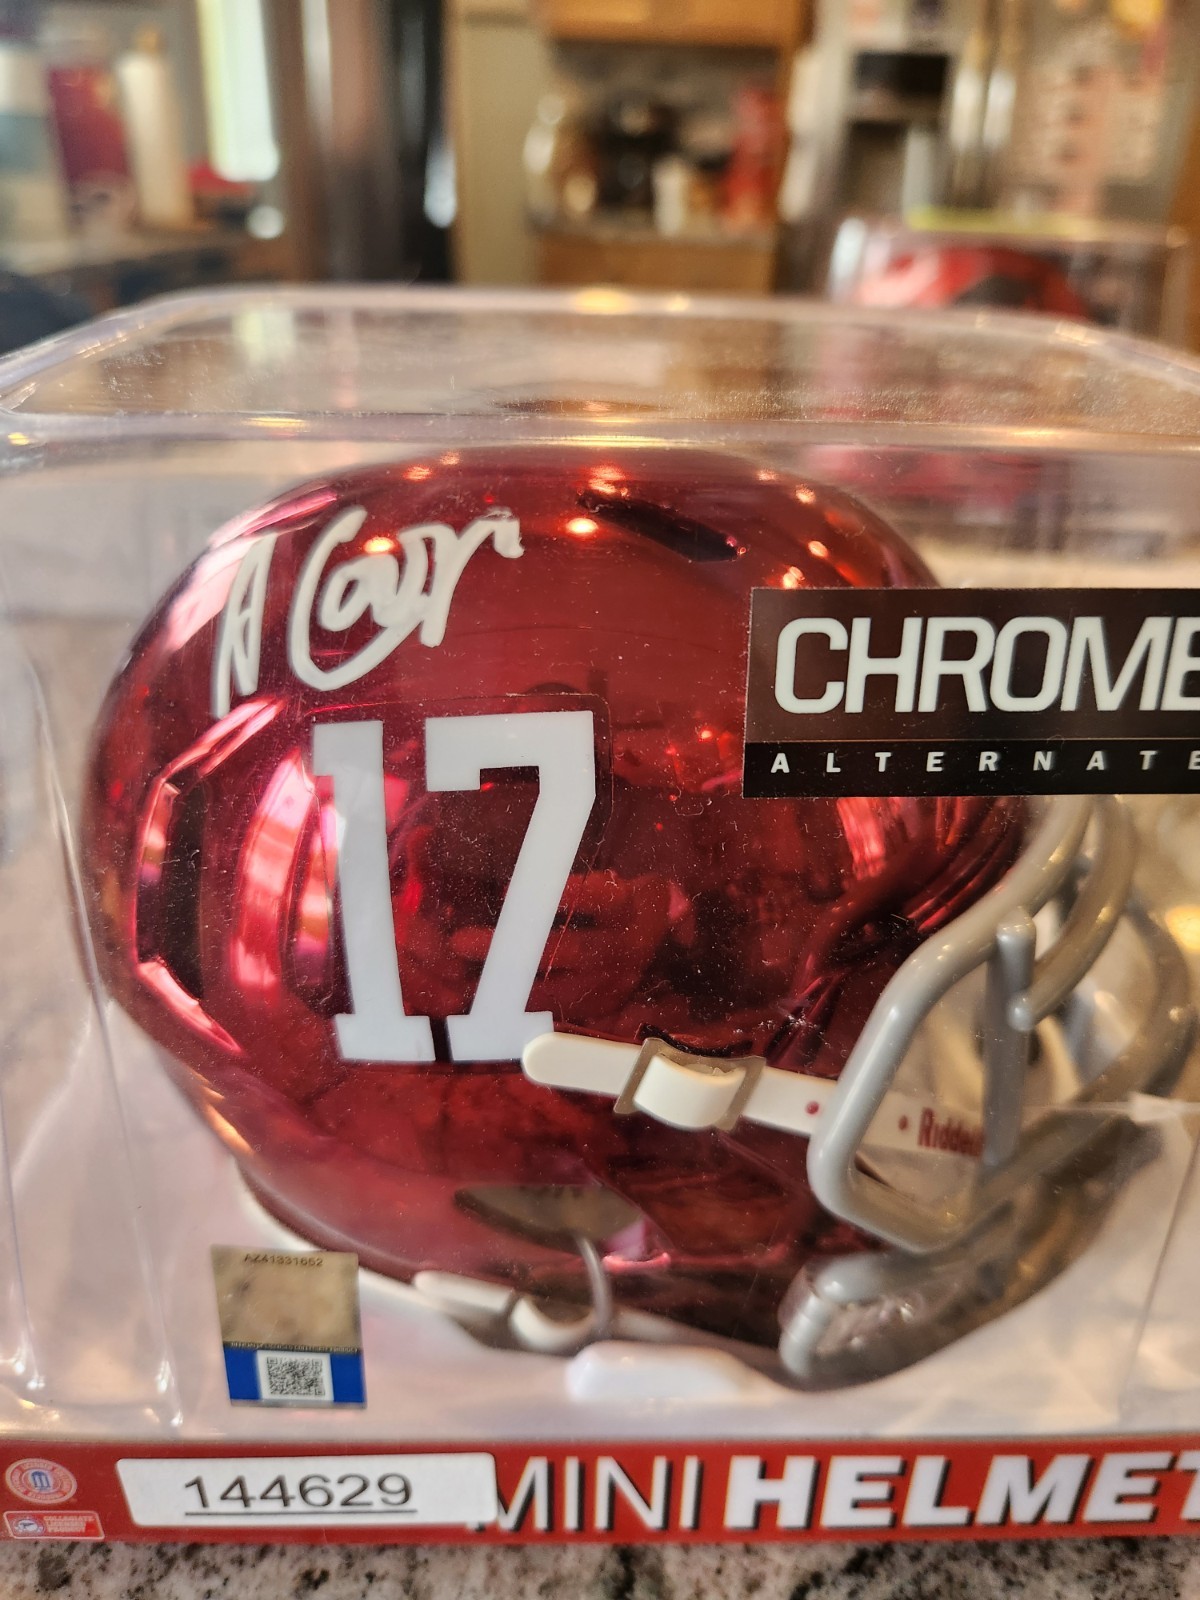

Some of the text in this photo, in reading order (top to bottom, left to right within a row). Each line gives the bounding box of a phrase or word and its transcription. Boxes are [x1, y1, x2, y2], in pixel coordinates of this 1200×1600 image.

[774, 616, 1200, 714] CHROME
[770, 749, 1200, 774] ALTERNATE
[313, 711, 597, 1063] 17
[184, 1473, 414, 1509] 144629
[722, 1451, 1200, 1531] HELME
